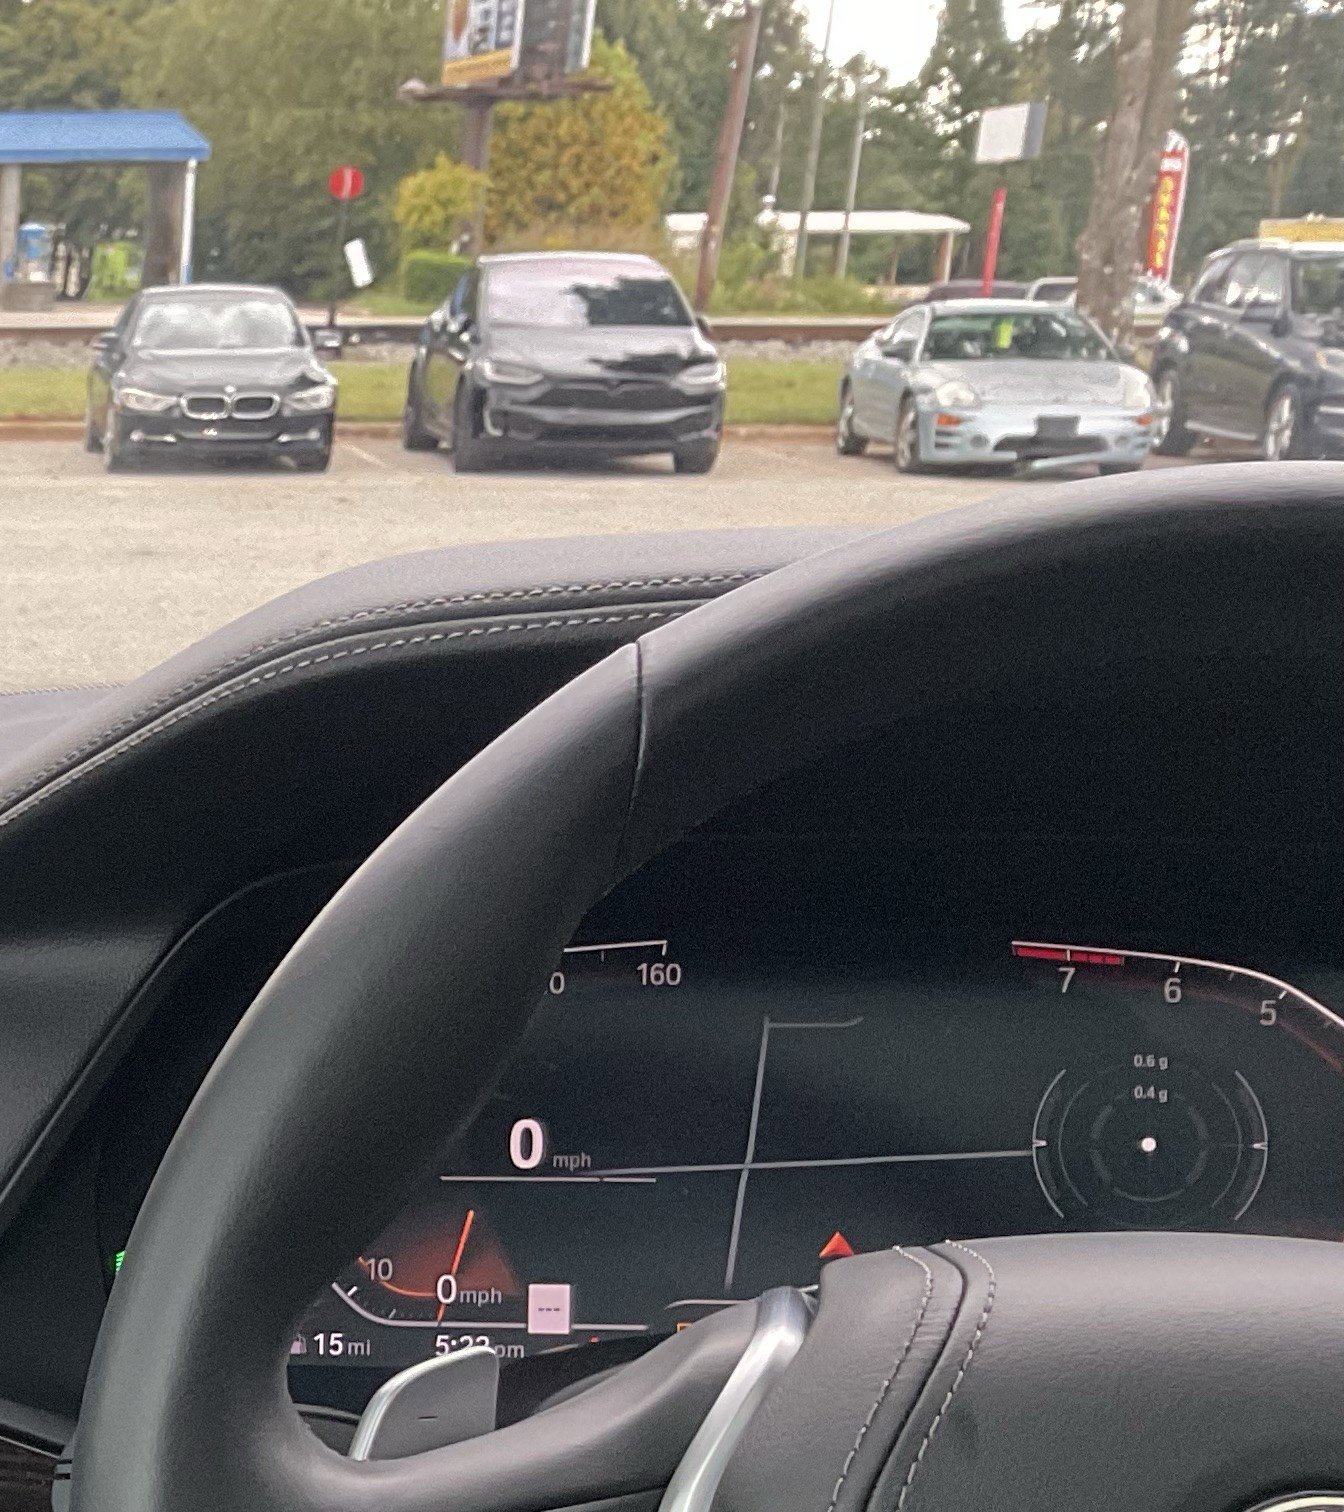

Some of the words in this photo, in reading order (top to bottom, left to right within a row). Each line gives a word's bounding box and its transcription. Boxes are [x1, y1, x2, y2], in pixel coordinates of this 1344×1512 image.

[636, 963, 682, 986] 160
[1058, 966, 1076, 993] 7
[1163, 976, 1183, 1003] 6
[1259, 999, 1278, 1026] 5
[1133, 1054, 1156, 1068] 0.6
[1133, 1084, 1156, 1100] 0.4
[509, 1118, 544, 1170] 0
[552, 1152, 592, 1172] mph
[367, 1258, 393, 1281] 10
[436, 1274, 458, 1304] 0
[459, 1287, 503, 1308] mph
[313, 1333, 345, 1356] 15
[347, 1338, 372, 1356] mi
